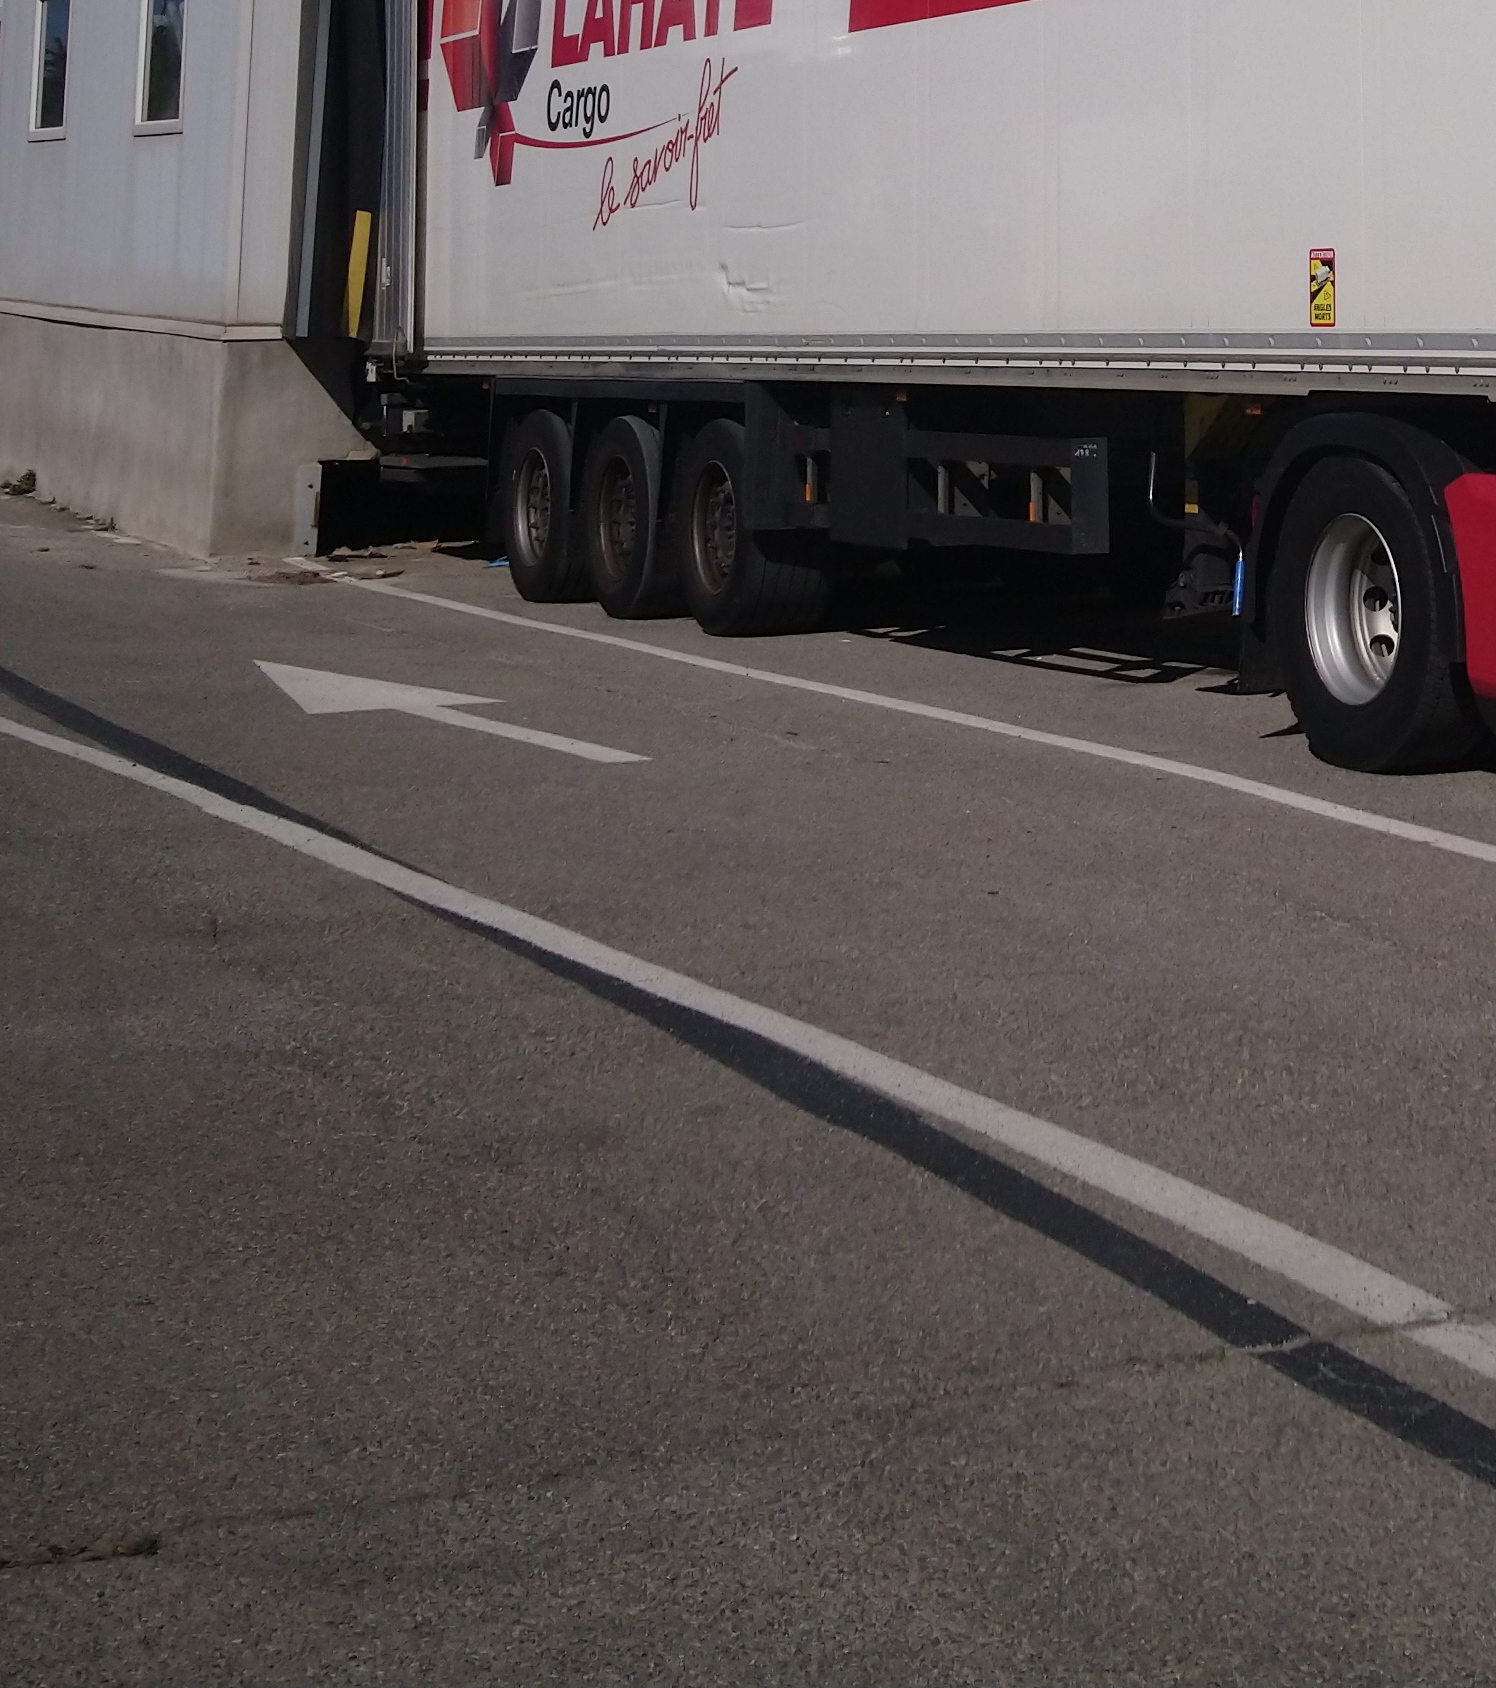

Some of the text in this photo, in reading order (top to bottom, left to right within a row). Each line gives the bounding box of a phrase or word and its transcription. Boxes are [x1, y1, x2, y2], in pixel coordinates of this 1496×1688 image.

[547, 79, 610, 139] Cargo
[593, 57, 738, 231] le savoir-fret
[1314, 312, 1331, 321] MORTS
